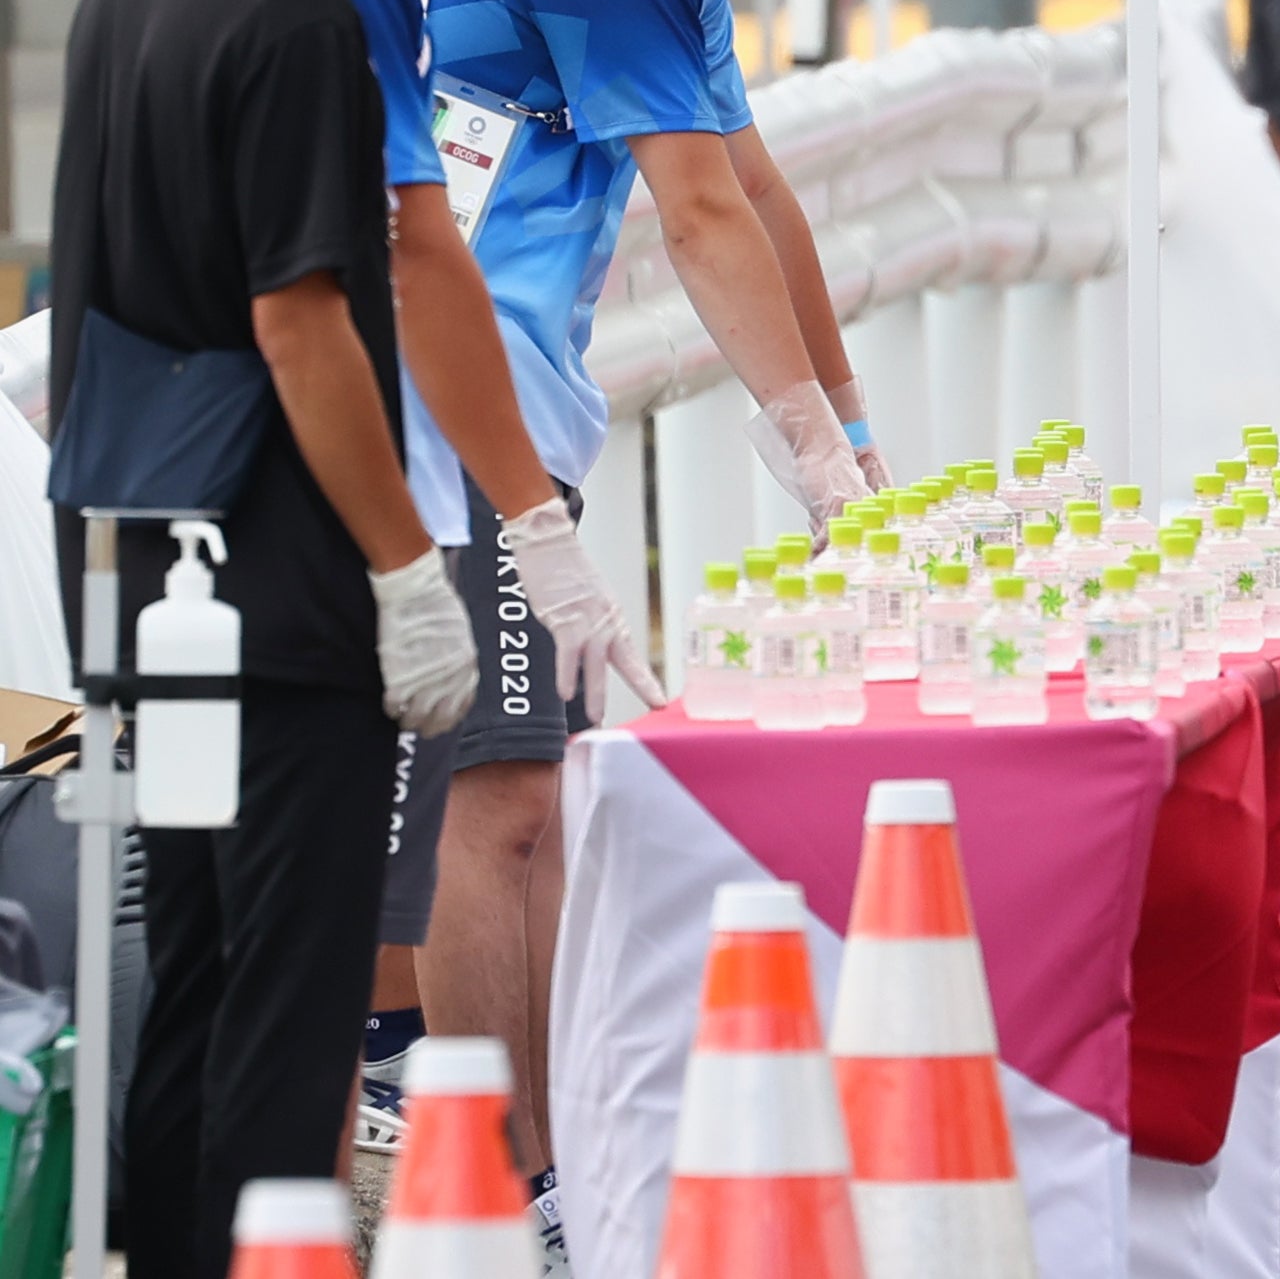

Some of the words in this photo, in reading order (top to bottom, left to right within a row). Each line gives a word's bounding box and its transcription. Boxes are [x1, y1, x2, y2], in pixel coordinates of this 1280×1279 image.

[452, 146, 479, 163] OCOG
[495, 513, 527, 622] OKYO
[499, 631, 531, 716] 2020
